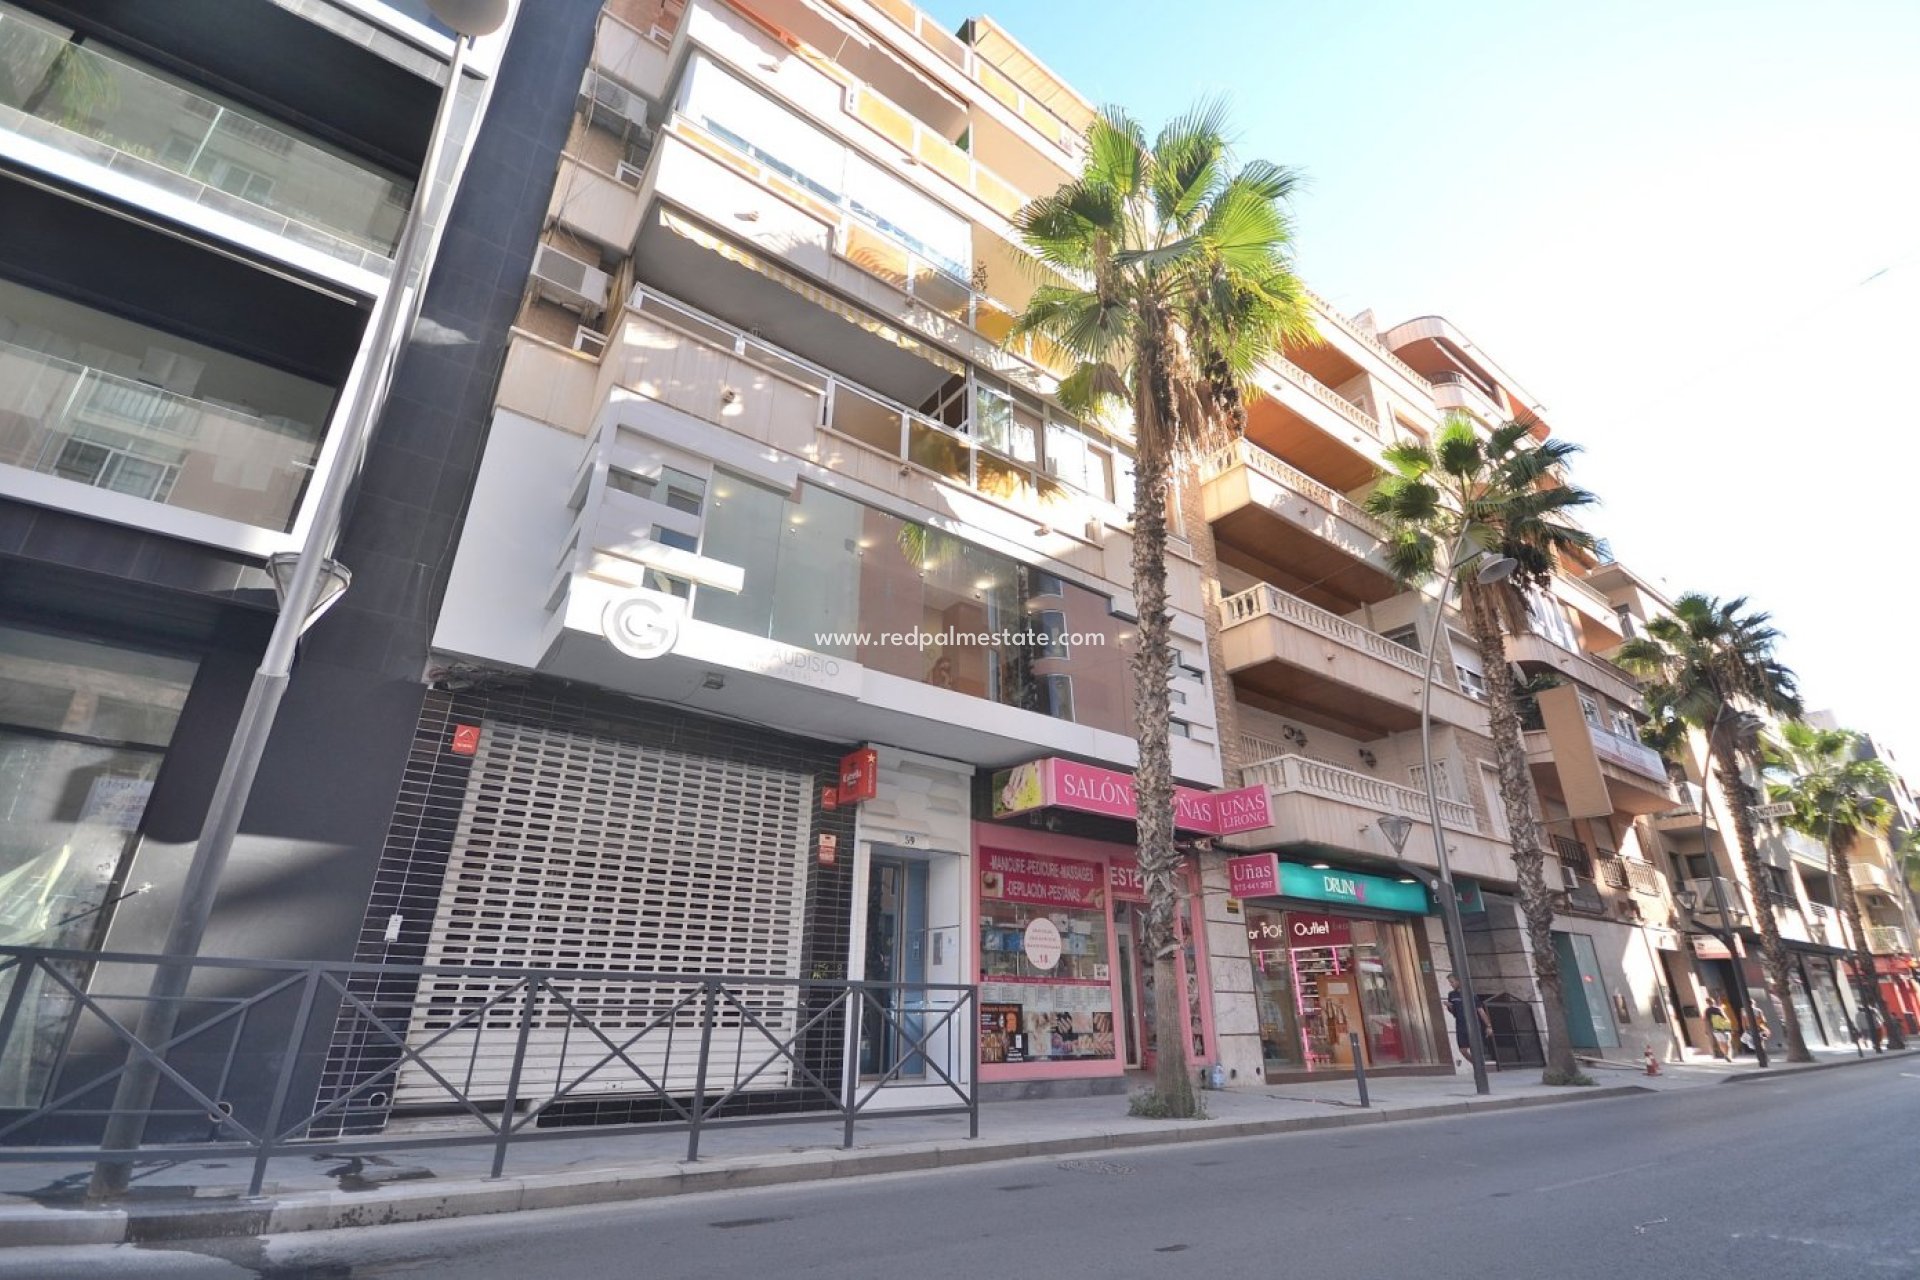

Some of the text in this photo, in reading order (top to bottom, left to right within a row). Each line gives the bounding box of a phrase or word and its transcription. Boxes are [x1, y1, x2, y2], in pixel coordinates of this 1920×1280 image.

[1063, 773, 1212, 823] SALÓN ÑAS
[1220, 793, 1265, 817] UÑAS
[1224, 811, 1265, 829] LIRONG
[1232, 864, 1271, 881] Uñas
[1294, 920, 1330, 936] Outlet
